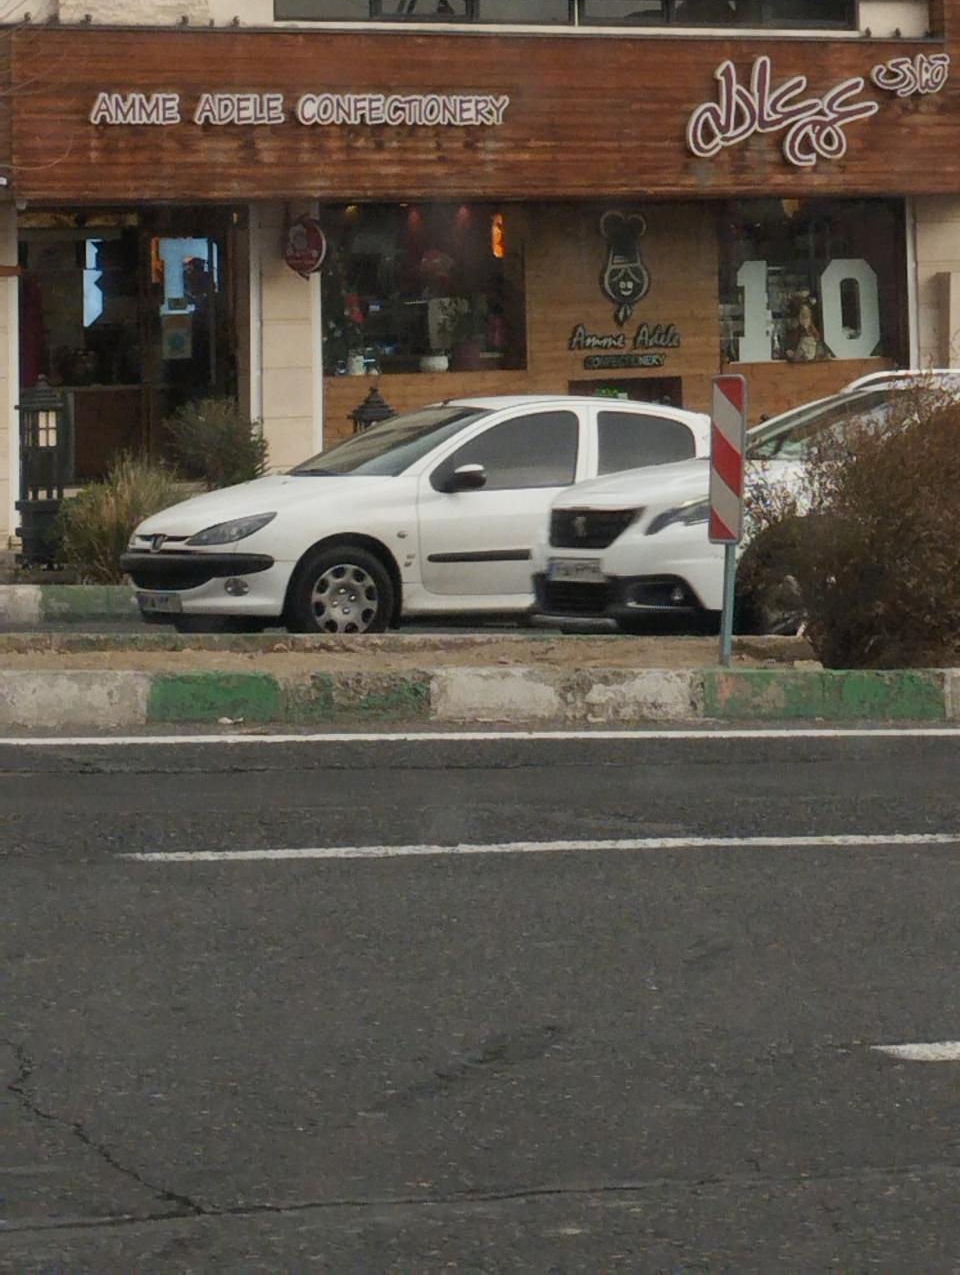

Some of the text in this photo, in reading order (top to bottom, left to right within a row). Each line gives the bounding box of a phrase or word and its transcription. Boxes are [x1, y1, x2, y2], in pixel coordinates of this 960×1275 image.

[90, 92, 510, 125] AMME ADELE CONFECTIONERY
[569, 323, 625, 350] Amme
